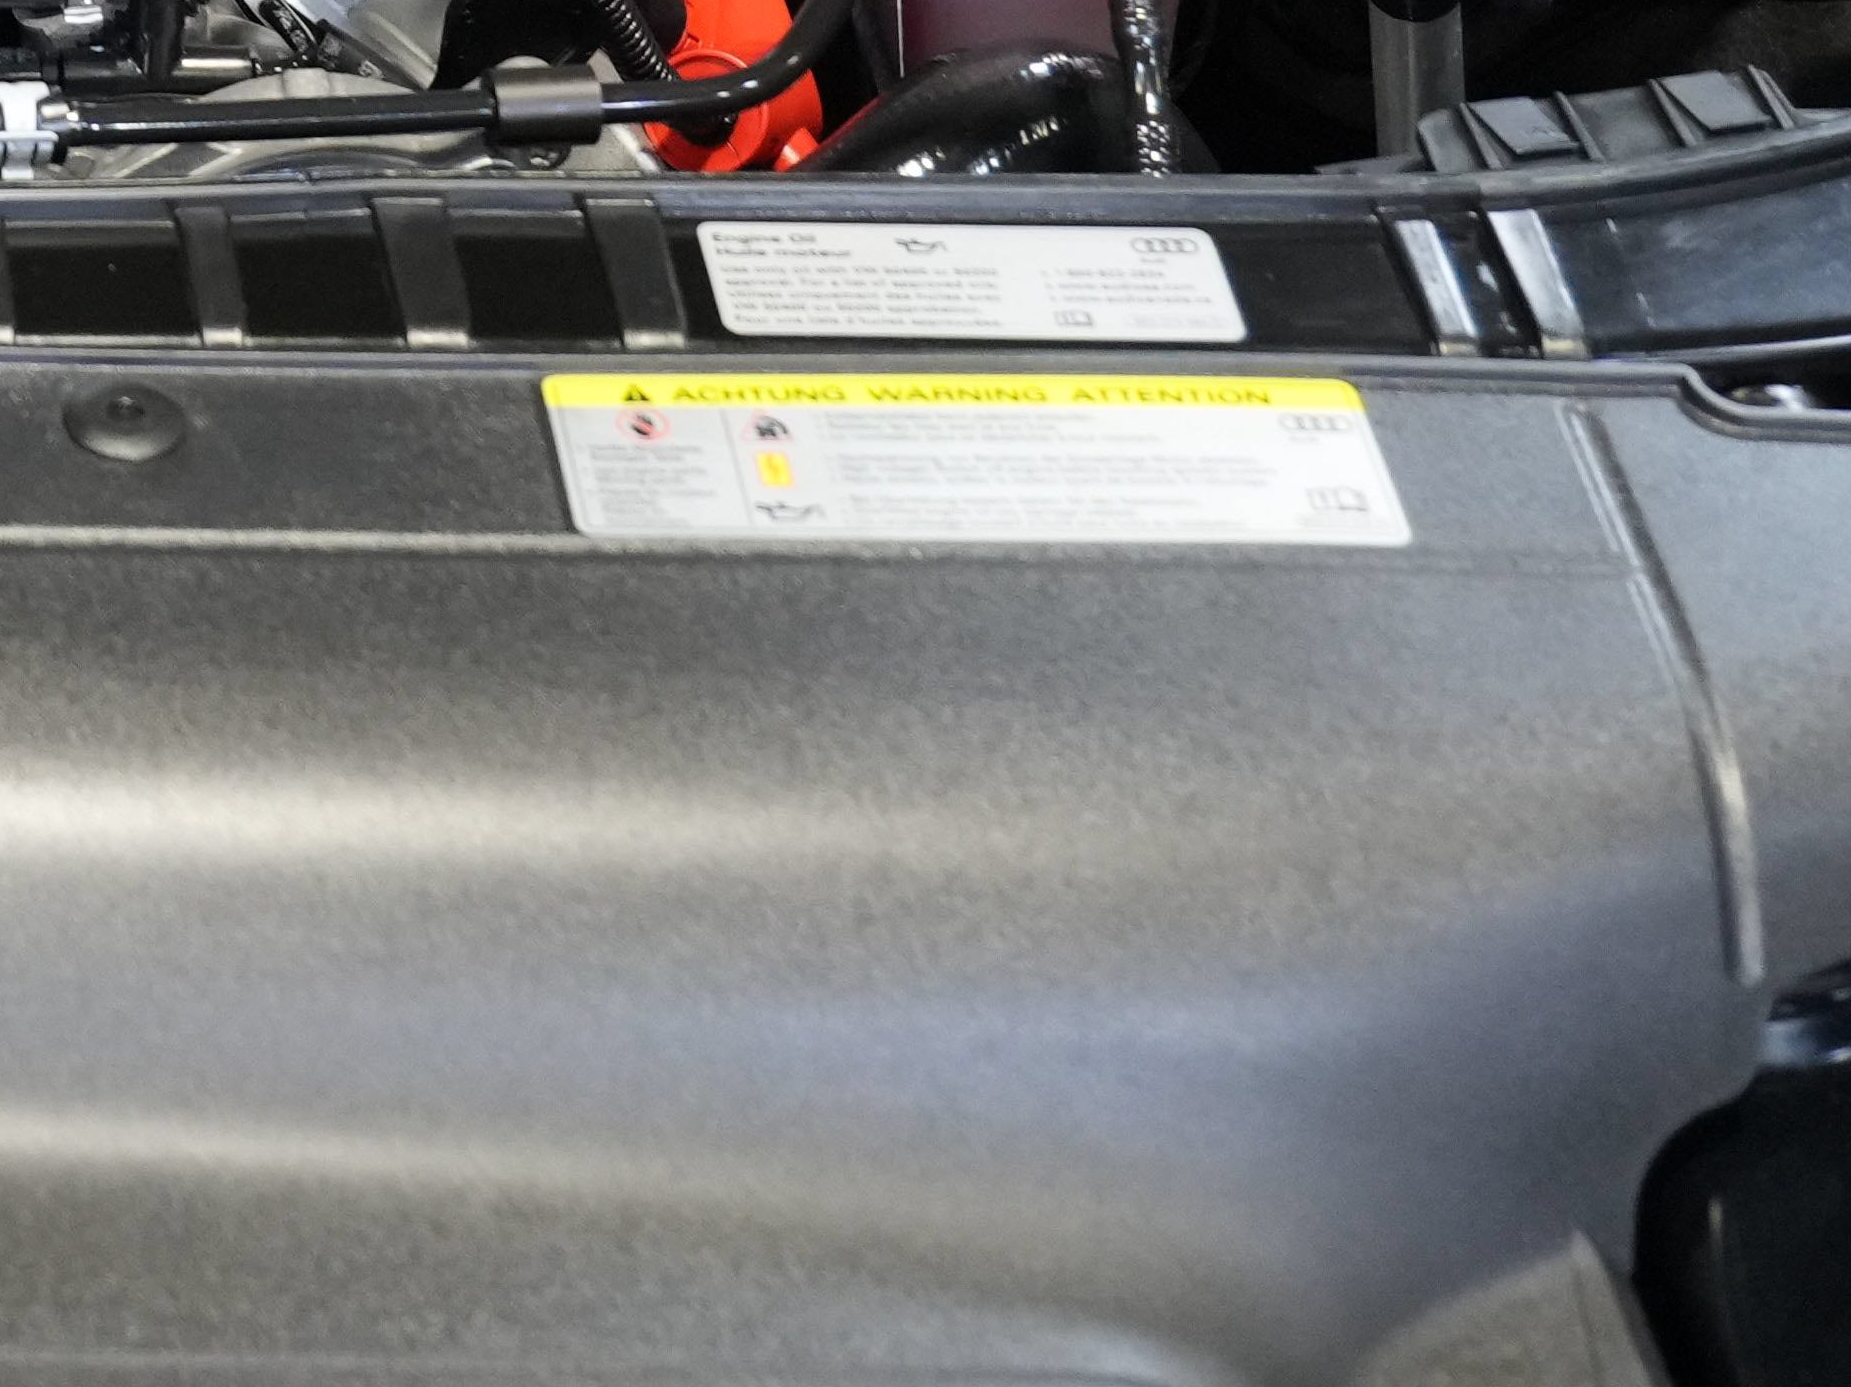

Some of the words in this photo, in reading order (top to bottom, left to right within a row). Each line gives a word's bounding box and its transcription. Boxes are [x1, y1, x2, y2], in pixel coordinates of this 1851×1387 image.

[673, 385, 846, 402] ACHTUNG
[867, 386, 1049, 403] WARNING
[1071, 387, 1273, 405] ATTENTION
